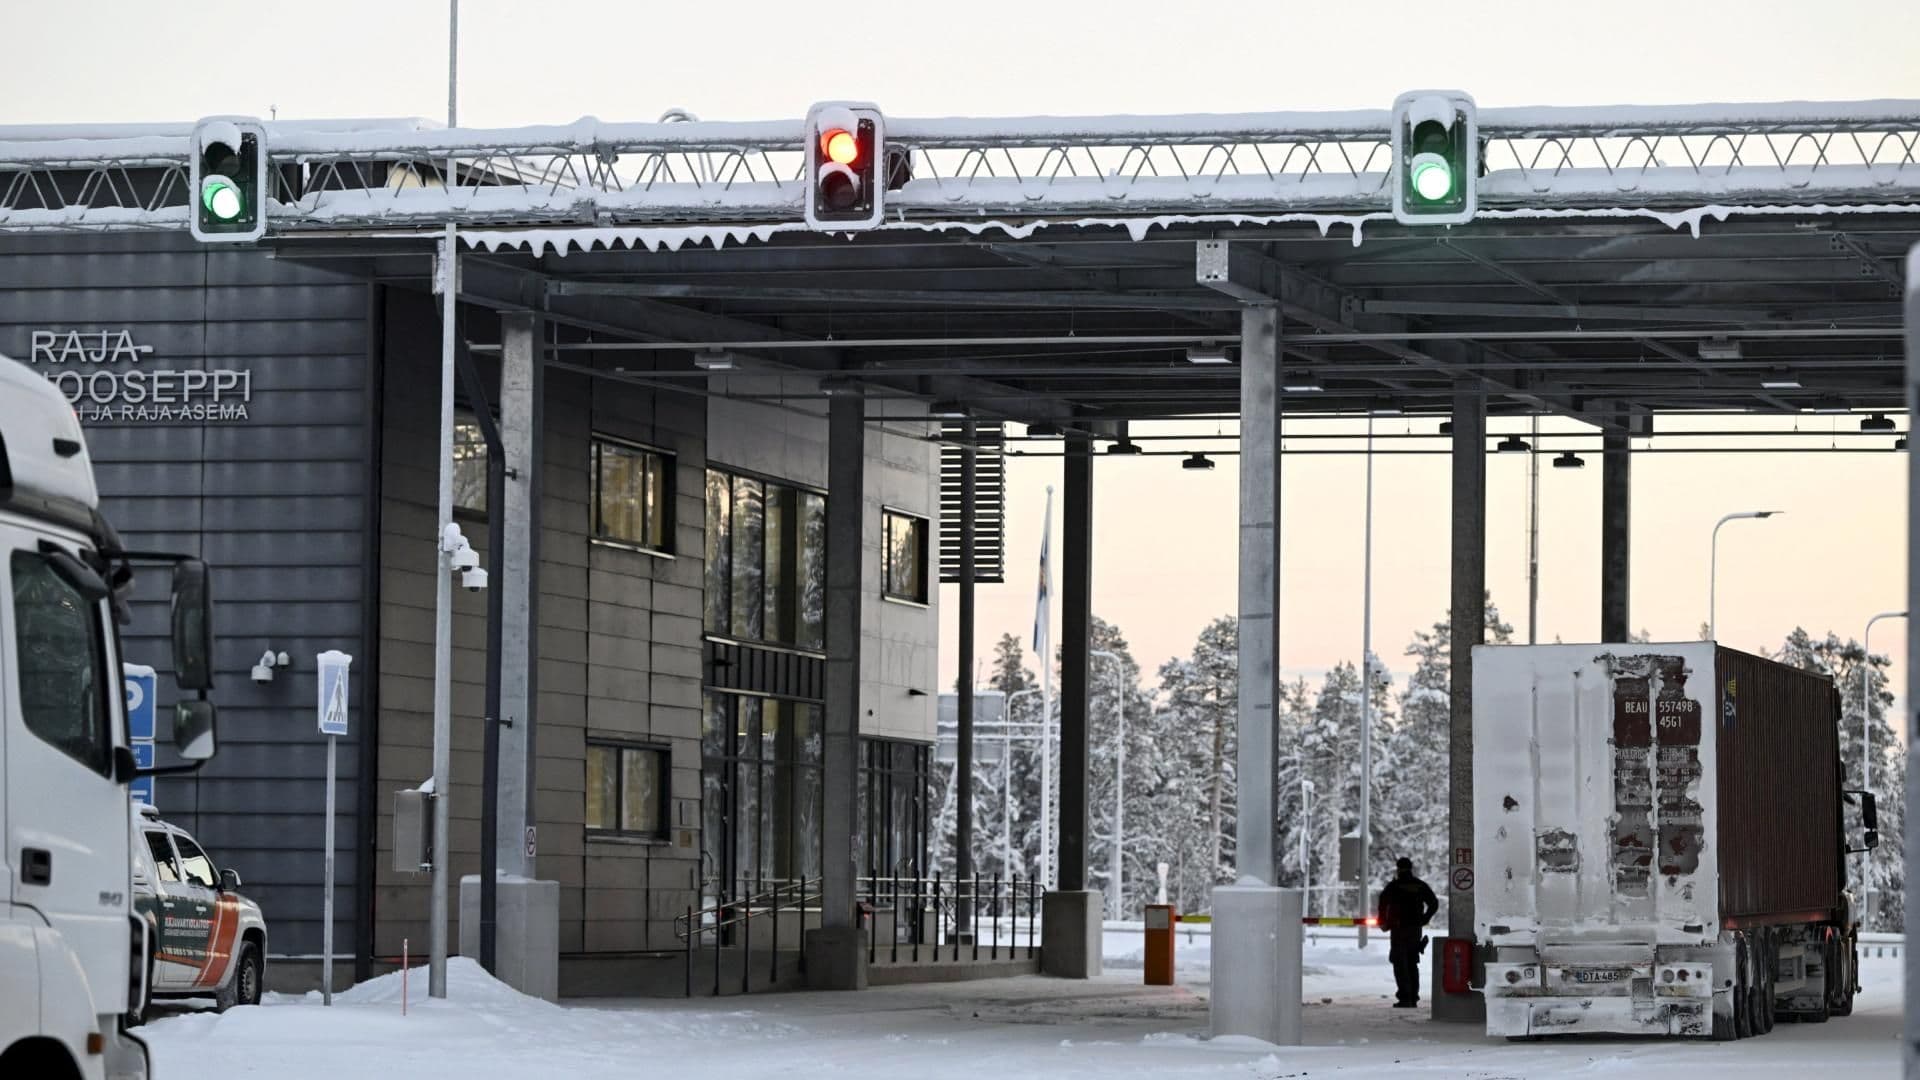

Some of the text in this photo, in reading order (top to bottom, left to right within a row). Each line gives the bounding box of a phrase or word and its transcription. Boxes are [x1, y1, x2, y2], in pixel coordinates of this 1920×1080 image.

[31, 330, 153, 363] RAJA-
[43, 369, 251, 403] OOSEPPI
[91, 404, 114, 421] JA
[121, 403, 249, 420] RAJA-ASEMA
[1625, 701, 1648, 713] BEAU
[1660, 715, 1682, 728] 45G1
